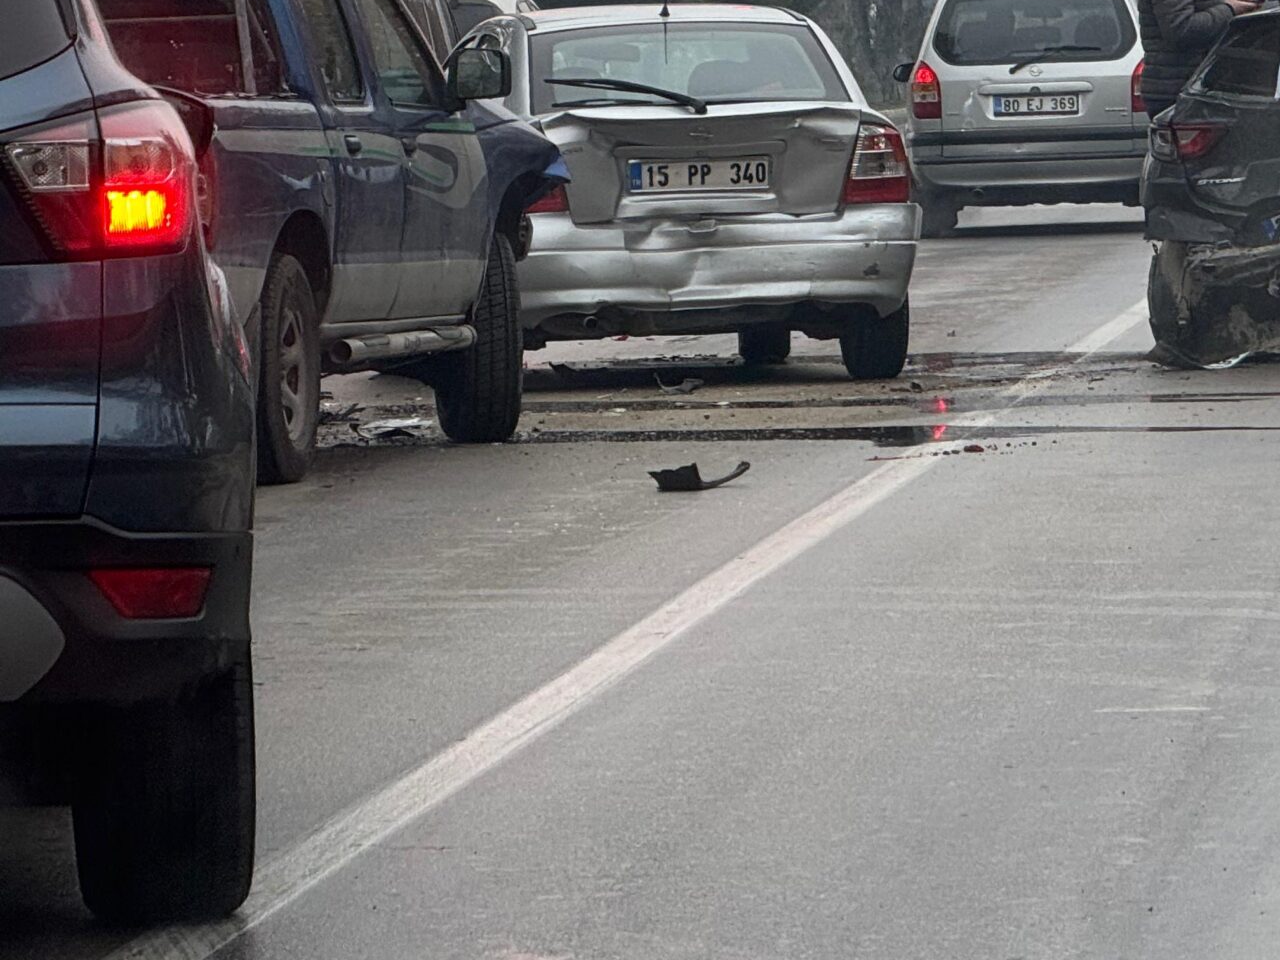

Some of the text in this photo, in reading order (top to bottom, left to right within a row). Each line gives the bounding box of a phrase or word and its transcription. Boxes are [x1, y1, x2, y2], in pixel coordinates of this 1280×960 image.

[1003, 97, 1075, 112] 80 EJ 369
[647, 162, 766, 187] 15 PP 340
